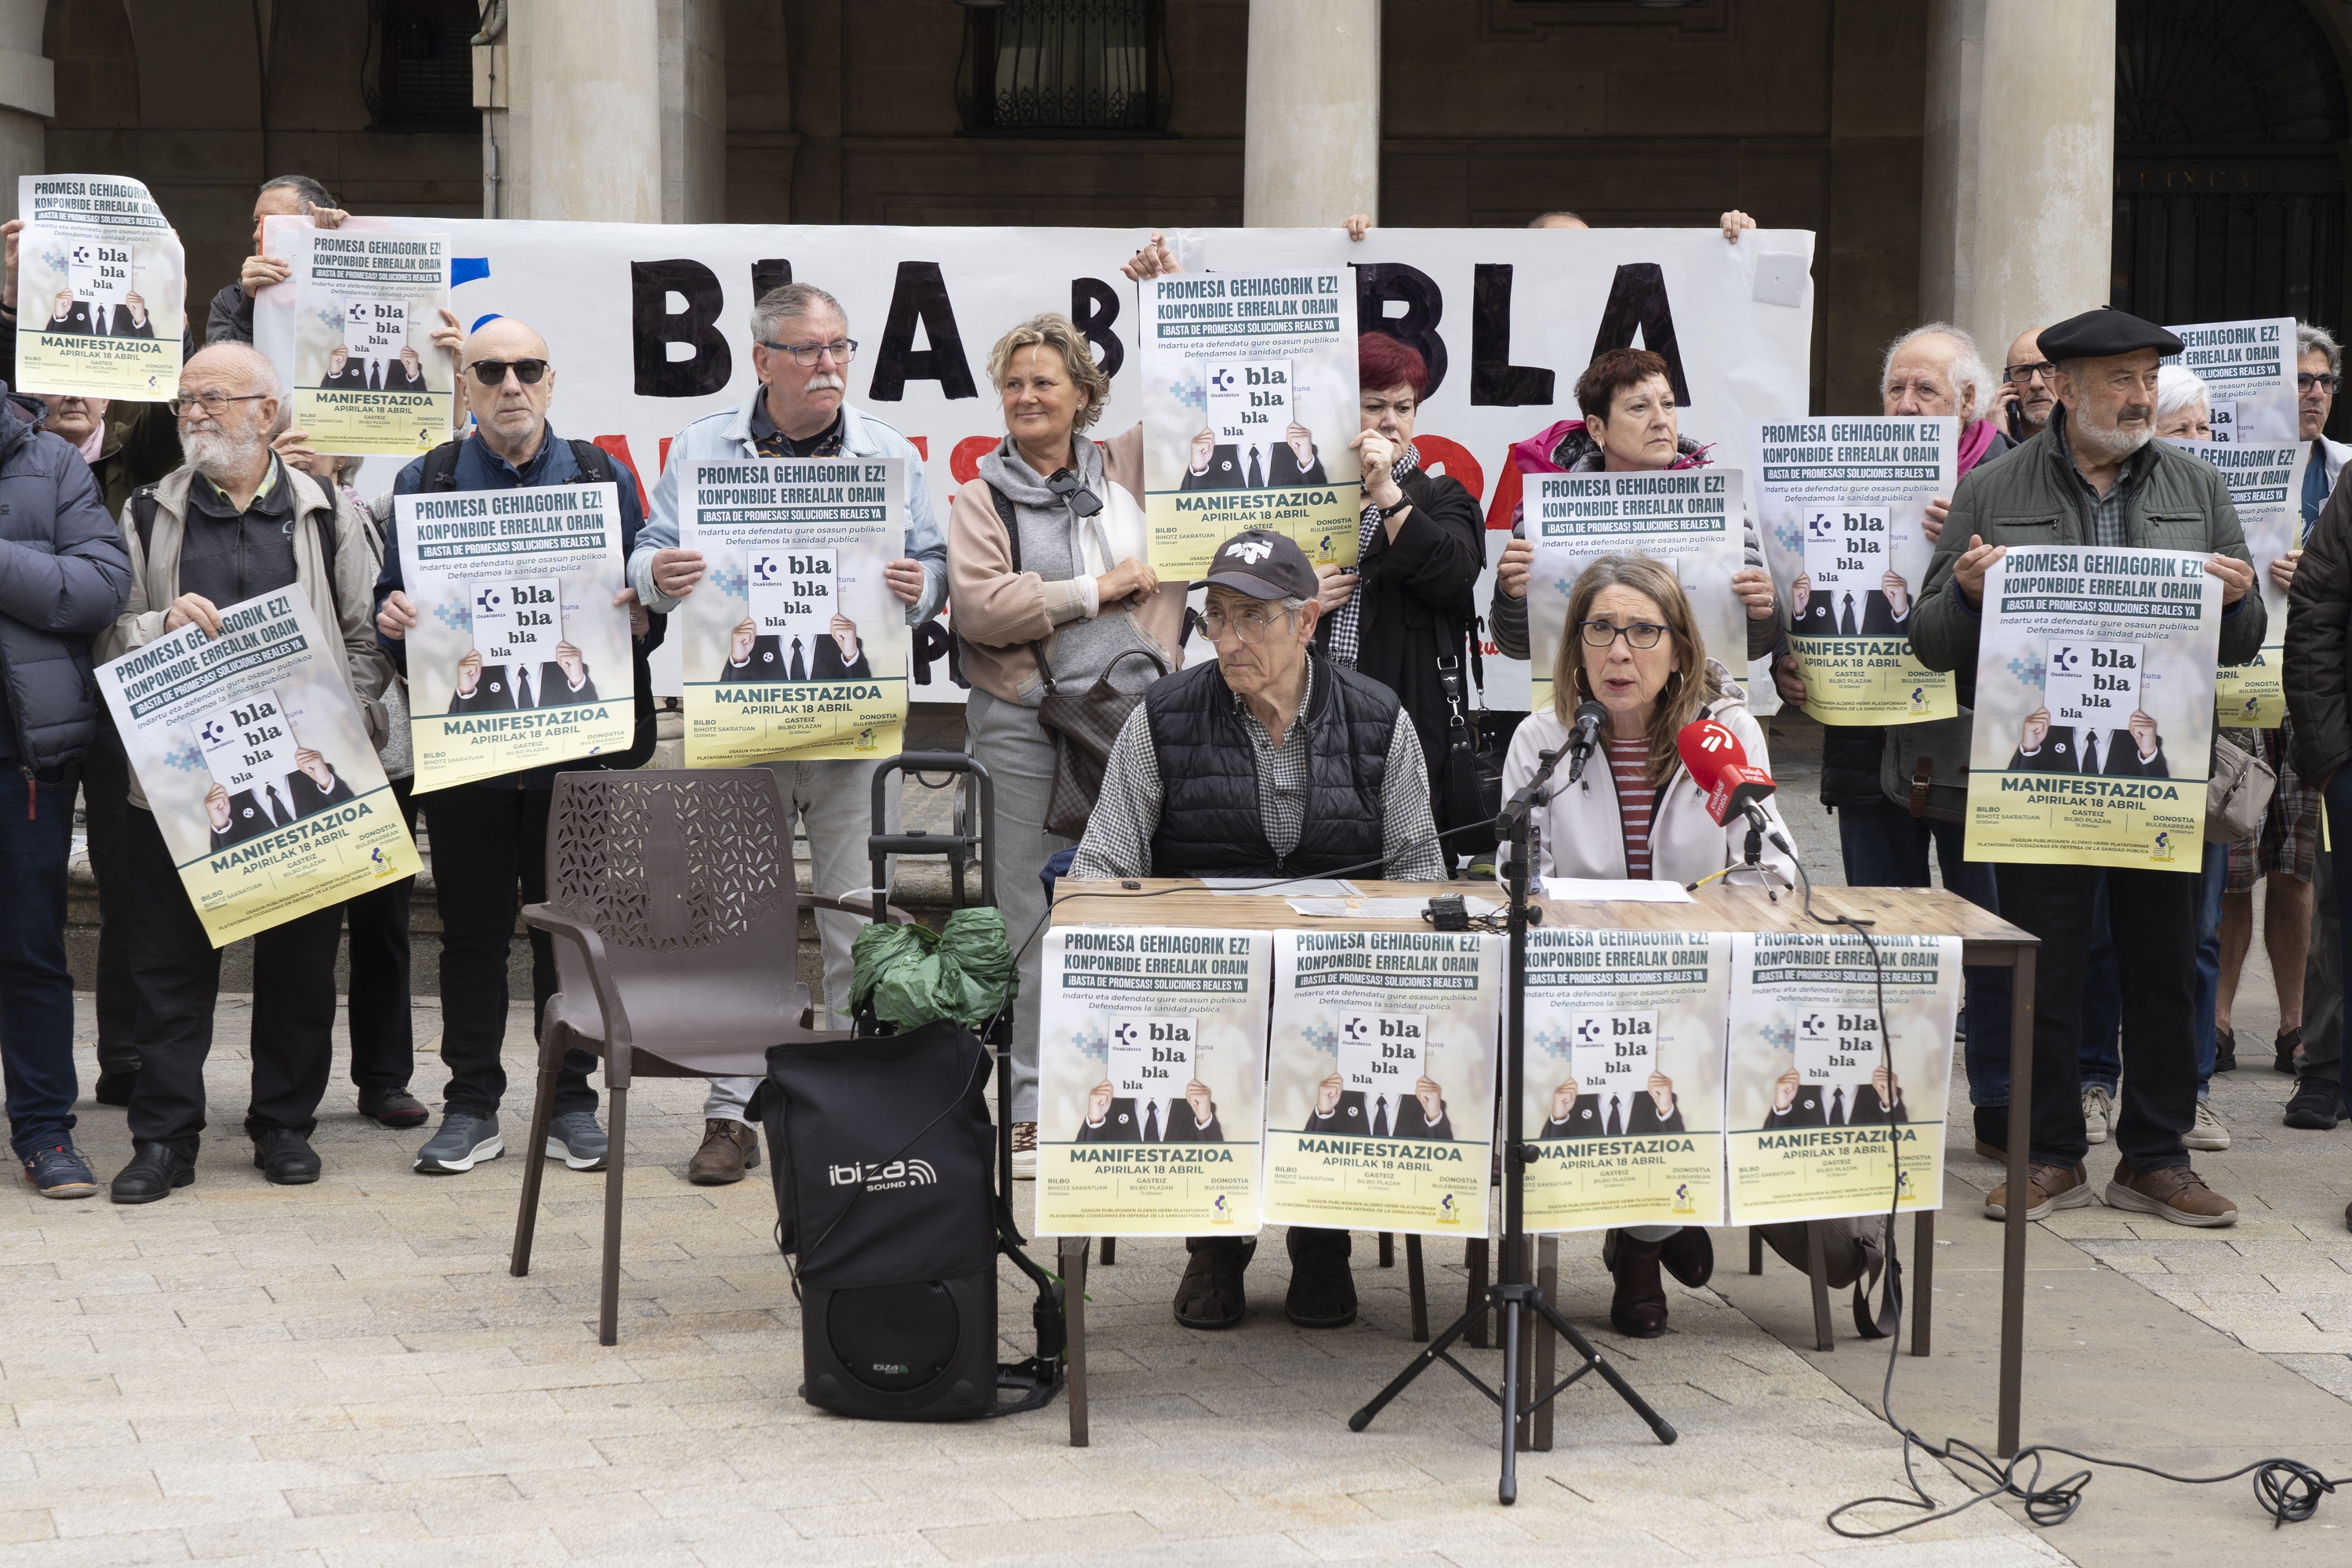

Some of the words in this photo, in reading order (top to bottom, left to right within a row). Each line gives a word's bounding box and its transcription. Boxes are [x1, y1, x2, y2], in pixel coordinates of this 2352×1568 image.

[314, 238, 365, 252] PROMESA
[368, 241, 426, 255] GEHIAGORIK
[430, 242, 441, 255] EZ!
[314, 254, 368, 267] KONPONBIDE
[372, 257, 416, 269] ERREALAK
[419, 259, 441, 270] ORAIN
[1158, 280, 1225, 299] PROMESA
[1230, 278, 1312, 296] GEHIAGORIK
[1318, 276, 1338, 293] EZ!
[1158, 303, 1232, 319] KONPONBIDE
[1237, 300, 1297, 317] ERREALAK
[1302, 299, 1338, 314] ORAIN
[42, 336, 161, 353] MANIFESTAZIOA
[2180, 327, 2256, 347] GEHIAGORIK
[2261, 326, 2280, 342] EZ!
[2187, 348, 2242, 365] ERREALAK
[2245, 346, 2280, 361] ORAIN
[1245, 367, 1287, 385] bla
[2195, 368, 2238, 378] SOLUCIONES
[2239, 366, 2266, 376] REALES
[2267, 365, 2277, 374] YA
[316, 394, 433, 405] MANIFESTAZIOA
[1249, 391, 1283, 406] bla
[1240, 412, 1269, 423] bla
[1223, 426, 1243, 435] bla
[1762, 424, 1826, 442] PROMESA
[1831, 424, 1915, 441] GEHIAGORIK
[1920, 424, 1940, 441] EZ!
[2200, 448, 2276, 467] GEHIAGORIK
[2277, 449, 2296, 466] EZ!
[698, 466, 768, 484] PROMESA
[775, 466, 859, 483] GEHIAGORIK
[866, 466, 885, 482] EZ!
[2260, 470, 2291, 485] ORAIN
[1542, 479, 1610, 497] PROMESA
[1616, 477, 1699, 495] GEHIAGORIK
[1704, 476, 1724, 492] EZ!
[2252, 491, 2275, 501] REALES
[2275, 490, 2283, 500] YA
[416, 498, 487, 519] PROMESA
[492, 493, 577, 514] GEHIAGORIK
[582, 491, 604, 509] EZ!
[1176, 492, 1336, 510] MANIFESTAZIOA
[1543, 501, 1617, 517] KONPONBIDE
[1623, 499, 1682, 515] ERREALAK
[1688, 497, 1723, 513] ORAIN
[703, 511, 730, 521] ¡BASTA
[732, 511, 742, 521] DE
[745, 510, 789, 521] PROMESAS!
[791, 510, 838, 520] SOLUCIONES
[840, 509, 869, 518] REALES
[871, 509, 880, 518] YA
[1201, 512, 1256, 521] APIRILAK
[1275, 509, 1309, 518] ABRIL
[1842, 513, 1884, 531] bla
[417, 521, 495, 540] KONPONBIDE
[500, 517, 562, 535] ERREALAK
[567, 514, 603, 531] ORAIN
[849, 525, 885, 534] publikoa
[1846, 538, 1880, 553] bla
[1836, 557, 1864, 569] bla
[2006, 554, 2078, 572] PROMESA
[2084, 555, 2175, 576] GEHIAGORIK
[2181, 559, 2202, 578] EZ!
[1818, 572, 1838, 581] bla
[124, 656, 199, 701] KONPONBIDE
[200, 632, 260, 666] ERREALAK
[260, 618, 299, 642] ORAIN
[2091, 648, 2136, 669] bla
[716, 686, 881, 702] MANIFESTAZIOA
[445, 707, 608, 735] MANIFESTAZIOA
[1711, 779, 1725, 810] euskadi
[2002, 778, 2178, 800] MANIFESTAZIOA
[1714, 793, 1729, 817] irratia
[211, 803, 372, 873] MANIFESTAZIOA
[243, 848, 297, 875] APIRILAK
[298, 843, 311, 852] 18
[315, 829, 350, 848] ABRIL
[1065, 934, 1134, 952] PROMESA
[1140, 935, 1223, 954] GEHIAGORIK
[1229, 937, 1251, 955] EZ!
[1297, 932, 1365, 951] PROMESA
[1370, 933, 1454, 951] GEHIAGORIK
[1460, 935, 1480, 952] EZ!
[1065, 955, 1141, 972] KONPONBIDE
[1145, 958, 1207, 974] ERREALAK
[1211, 960, 1247, 974] ORAIN
[1525, 952, 1601, 967] KONPONBIDE
[1606, 951, 1667, 966] ERREALAK
[1671, 950, 1708, 965] ORAIN
[1755, 950, 1830, 966] KONPONBIDE
[1901, 953, 1938, 967] ORAIN
[1070, 1149, 1232, 1162] MANIFESTAZIOA
[1298, 1139, 1462, 1161] MANIFESTAZIOA
[1538, 1139, 1695, 1159] MANIFESTAZIOA
[1783, 1148, 1835, 1159] APIRILAK
[1853, 1145, 1887, 1154] ABRIL
[1153, 1165, 1165, 1174] 18
[1559, 1159, 1613, 1170] APIRILAK
[1616, 1157, 1627, 1166] 18
[1631, 1156, 1665, 1165] ABRIL
[829, 1160, 905, 1185] ibiza
[867, 1181, 906, 1192] SOUND
